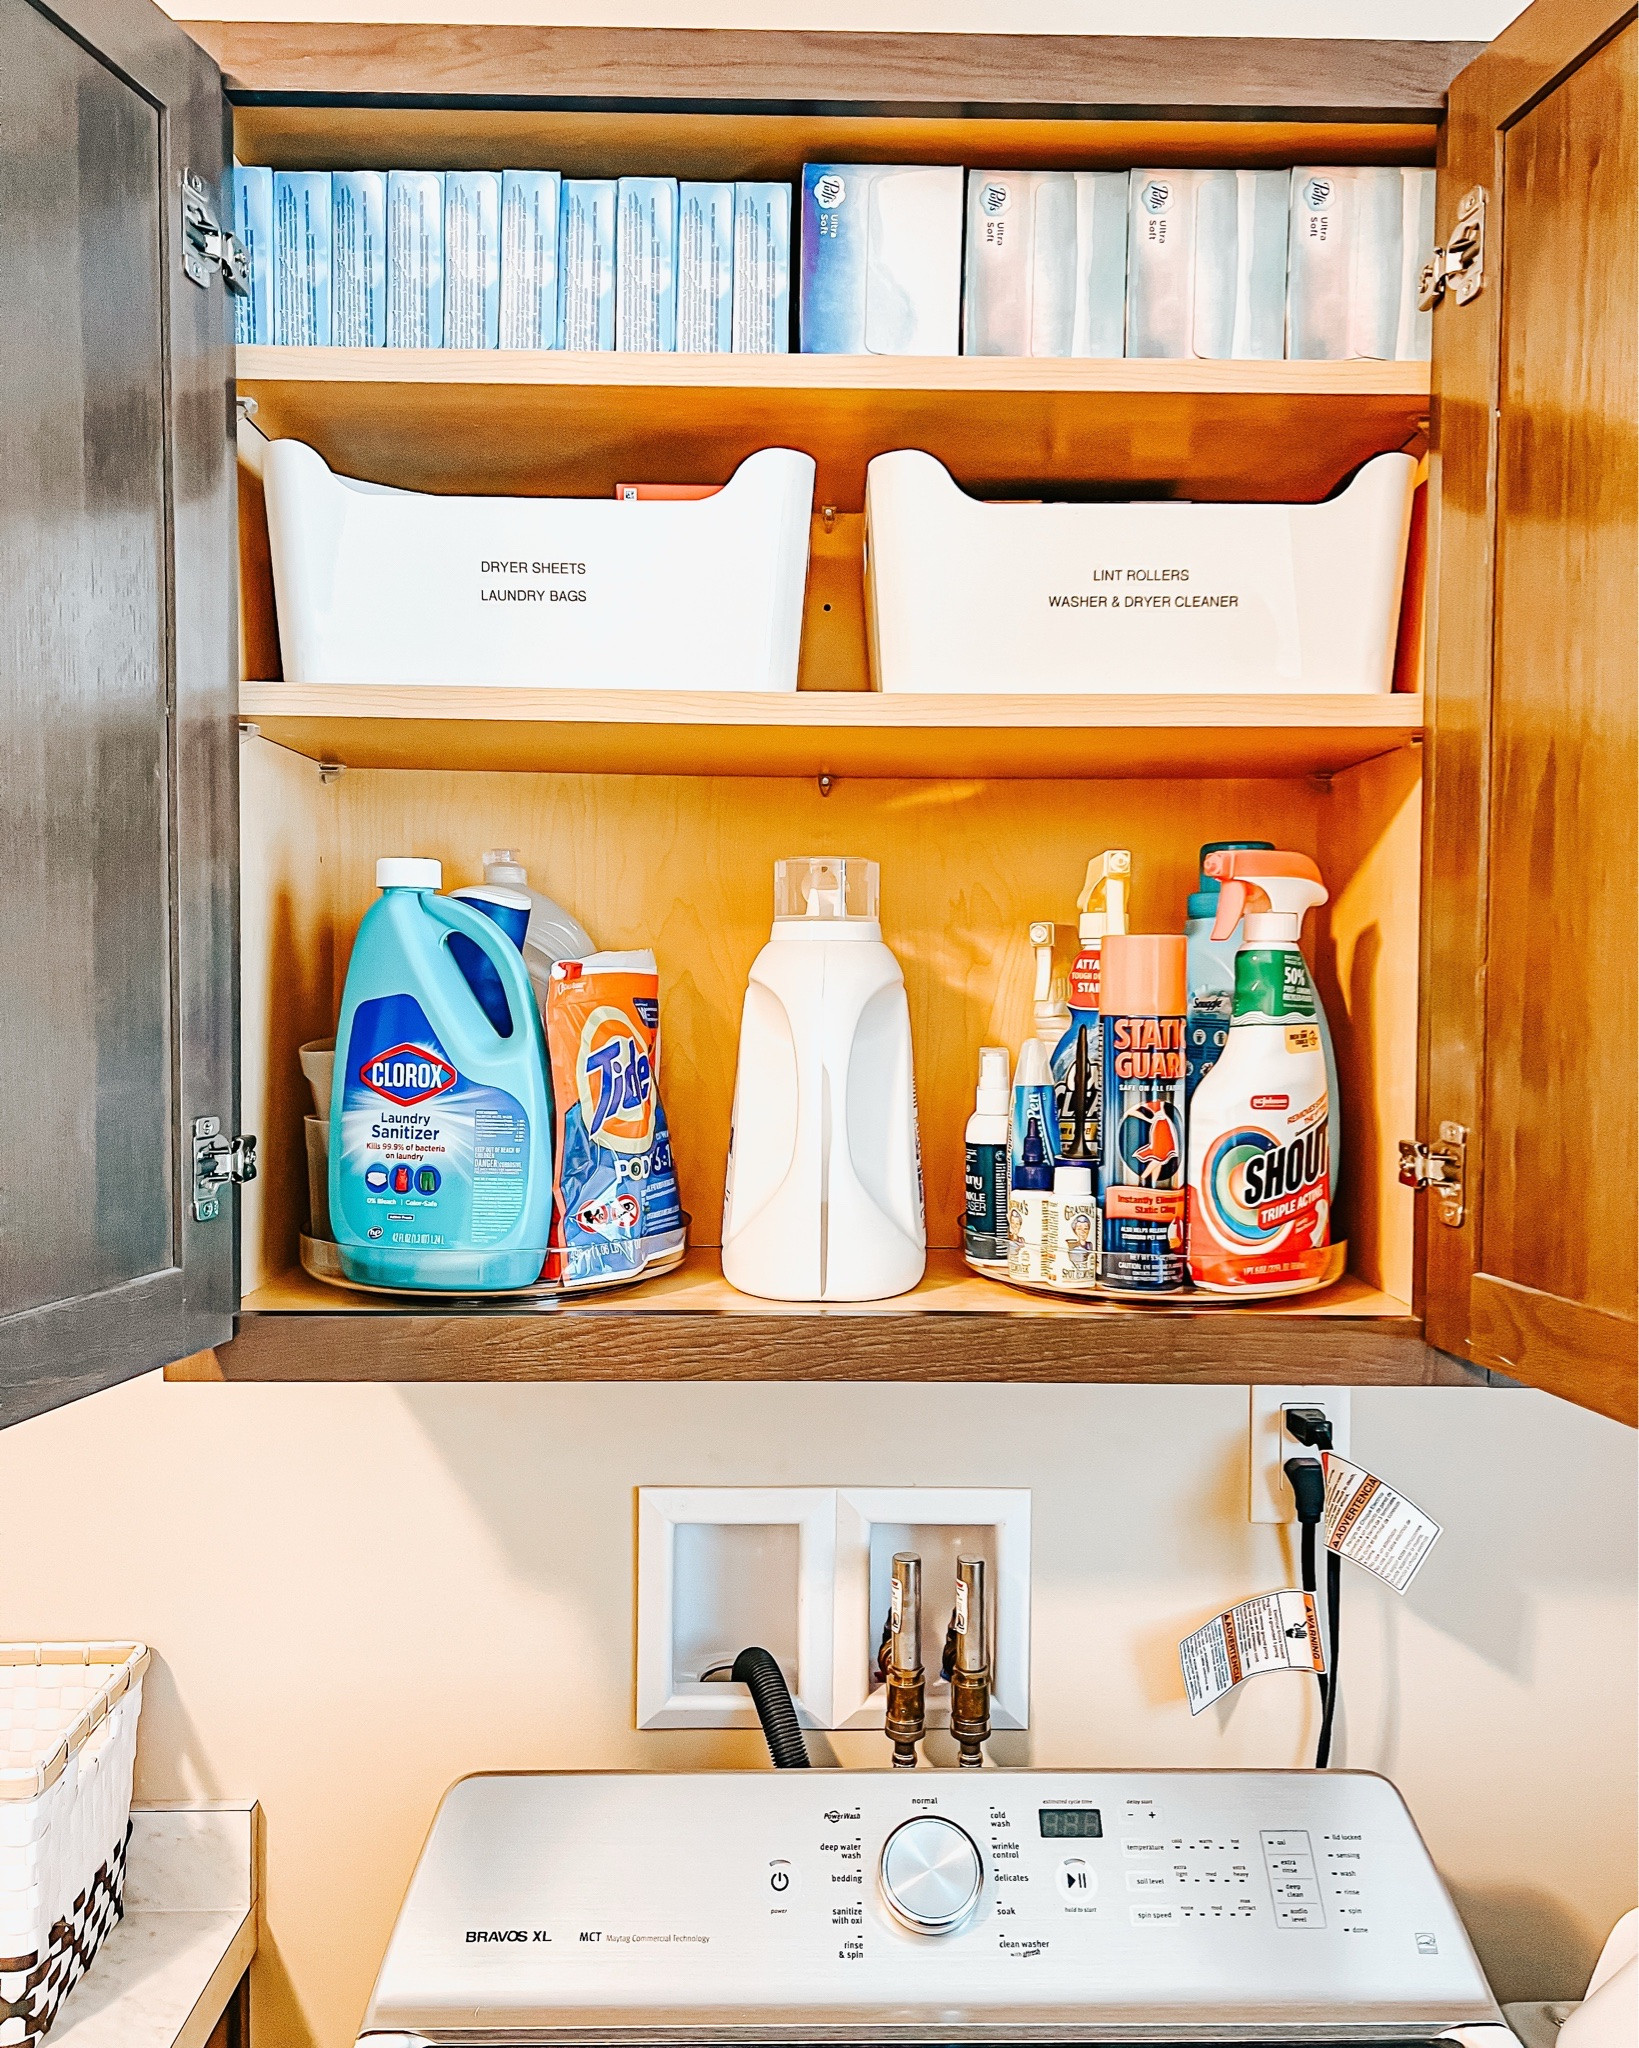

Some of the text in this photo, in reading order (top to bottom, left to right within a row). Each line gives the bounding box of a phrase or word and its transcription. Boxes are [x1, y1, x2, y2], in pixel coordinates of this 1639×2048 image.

[822, 180, 840, 204] Puffs
[1151, 185, 1169, 209] Puffs
[1312, 182, 1330, 206] Puffs
[989, 187, 1006, 212] Puffs
[830, 214, 839, 238] Ultra
[986, 222, 995, 242] Soft
[1148, 220, 1157, 240] Soft
[1159, 220, 1167, 244] Ultra
[1310, 216, 1318, 237] Soft
[1320, 216, 1328, 241] Ultra
[997, 222, 1005, 246] Ultra
[481, 561, 587, 575] DRYER SHEETS
[1093, 569, 1190, 581] LINT ROLLERS
[481, 589, 587, 602] LAUNDRY BAGS
[1048, 596, 1239, 608] WASHER & DRYER CLEANER
[1076, 959, 1100, 970] ATTA
[1284, 966, 1306, 986] 50%
[1077, 982, 1100, 993] STAI
[1193, 998, 1222, 1011] Snuggle
[372, 1062, 443, 1089] CLOROX
[585, 1039, 651, 1136] Tide
[381, 1112, 431, 1126] Laundry
[371, 1125, 440, 1141] Sanitizer
[366, 1142, 446, 1152] Kills 99.9% of bacteria
[396, 1153, 424, 1162] laundry
[1135, 1206, 1158, 1214] Static
[1261, 1200, 1296, 1224] TRIPLE
[1338, 1476, 1378, 1541] ADVERTENCIA
[1306, 1614, 1320, 1659] WARNING
[1224, 1621, 1241, 1682] ADVERTENCIA
[824, 1811, 861, 1822] PowerWash
[820, 1843, 839, 1852] deep
[991, 1842, 1020, 1850] wrinkle
[1127, 1844, 1164, 1852] temperature
[992, 1851, 1019, 1859] control
[831, 1875, 863, 1884] bedding
[994, 1874, 1029, 1882] delicates
[832, 1907, 863, 1915] sanitize
[997, 1907, 1016, 1915] soak
[1137, 1912, 1152, 1920] spin
[832, 1916, 849, 1924] with
[465, 1930, 552, 1943] BRAVOS XL
[579, 1931, 711, 1944] MCT Maytag Commercial Technology
[844, 1941, 864, 1949] rinse
[999, 1940, 1050, 1948] clean washer
[838, 1951, 864, 1960] & spin
